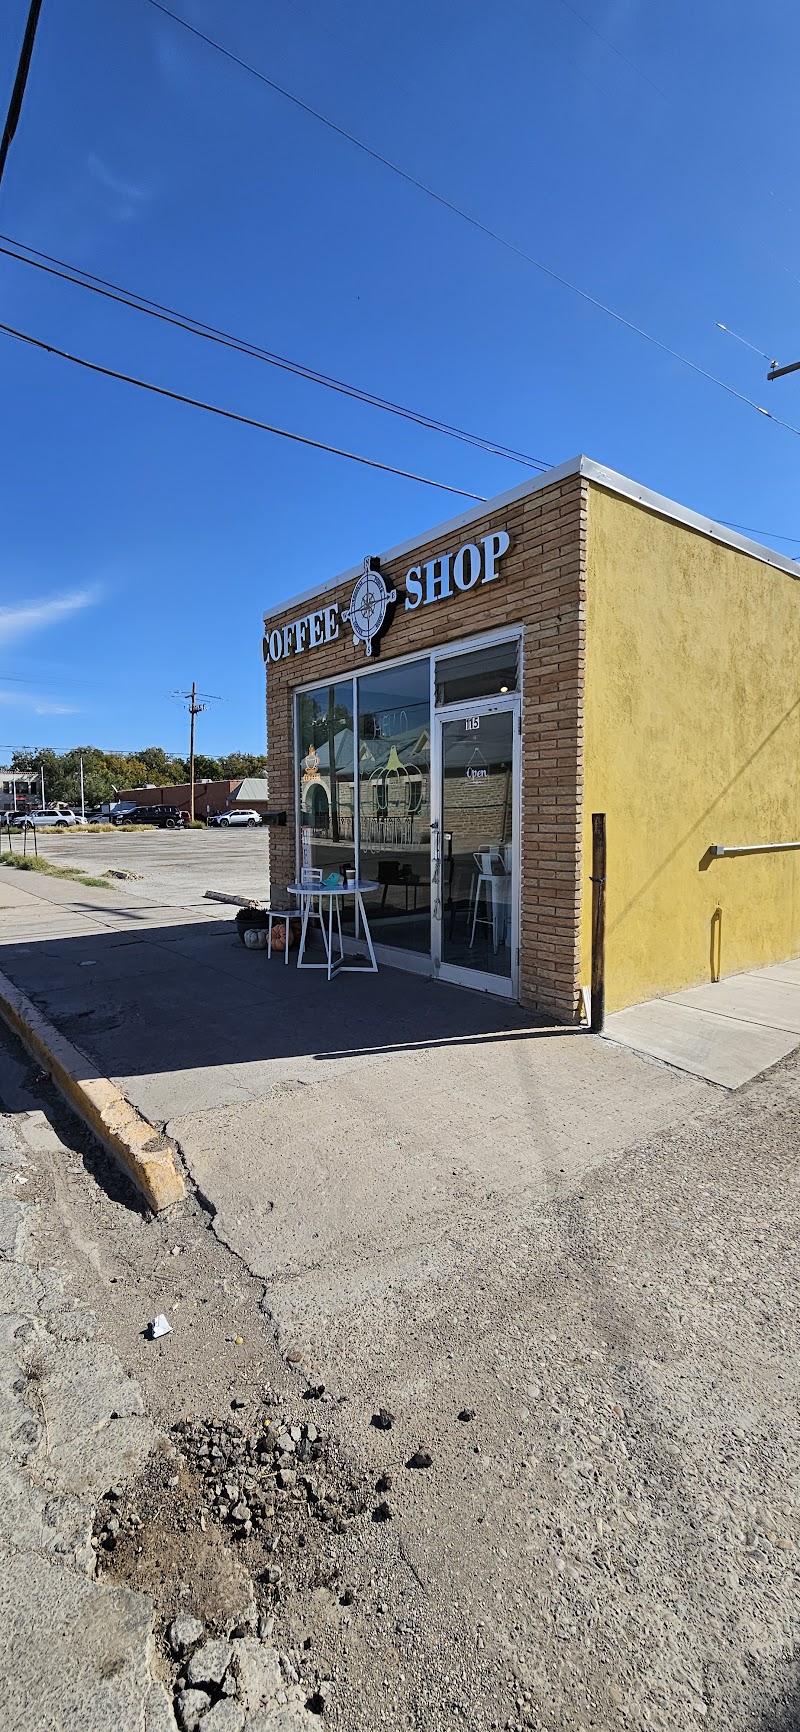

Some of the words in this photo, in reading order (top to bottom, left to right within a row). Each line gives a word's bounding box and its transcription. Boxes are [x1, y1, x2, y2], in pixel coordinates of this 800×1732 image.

[260, 602, 340, 664] COFFEE
[404, 530, 511, 610] SHOP
[465, 717, 479, 730] 115
[466, 766, 488, 780] Open
